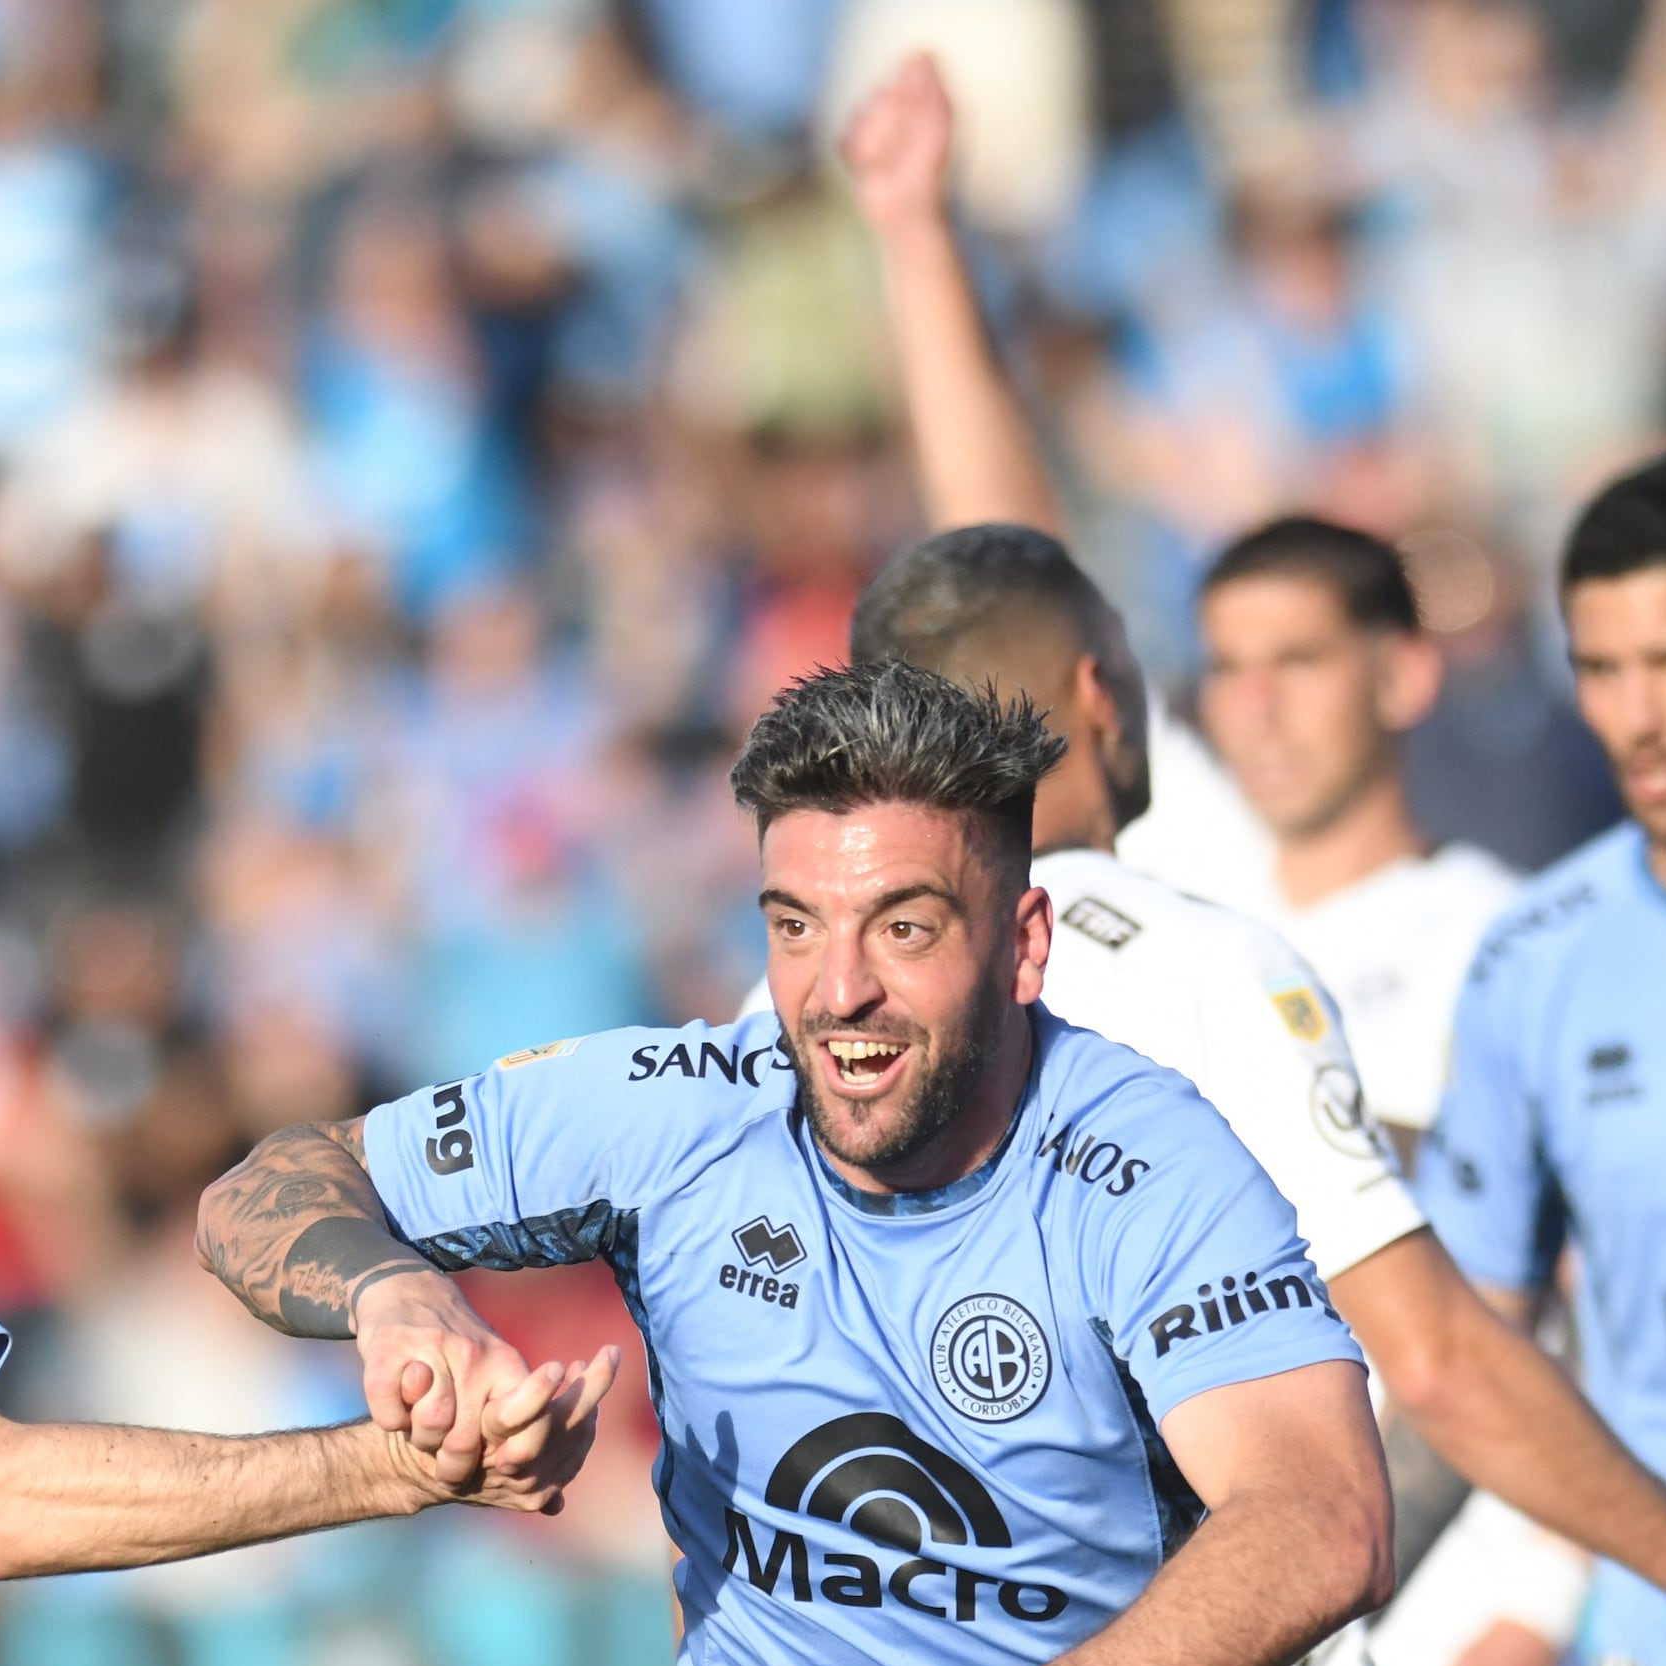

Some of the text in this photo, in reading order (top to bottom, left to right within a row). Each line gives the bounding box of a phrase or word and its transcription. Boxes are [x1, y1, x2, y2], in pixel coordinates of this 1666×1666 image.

[1033, 1111, 1151, 1197] ANOS
[936, 1299, 1045, 1384] CLUB ATLETICO BELGRANO
[961, 1393, 1030, 1416] CORDOBA
[722, 1505, 1070, 1622] Macro
